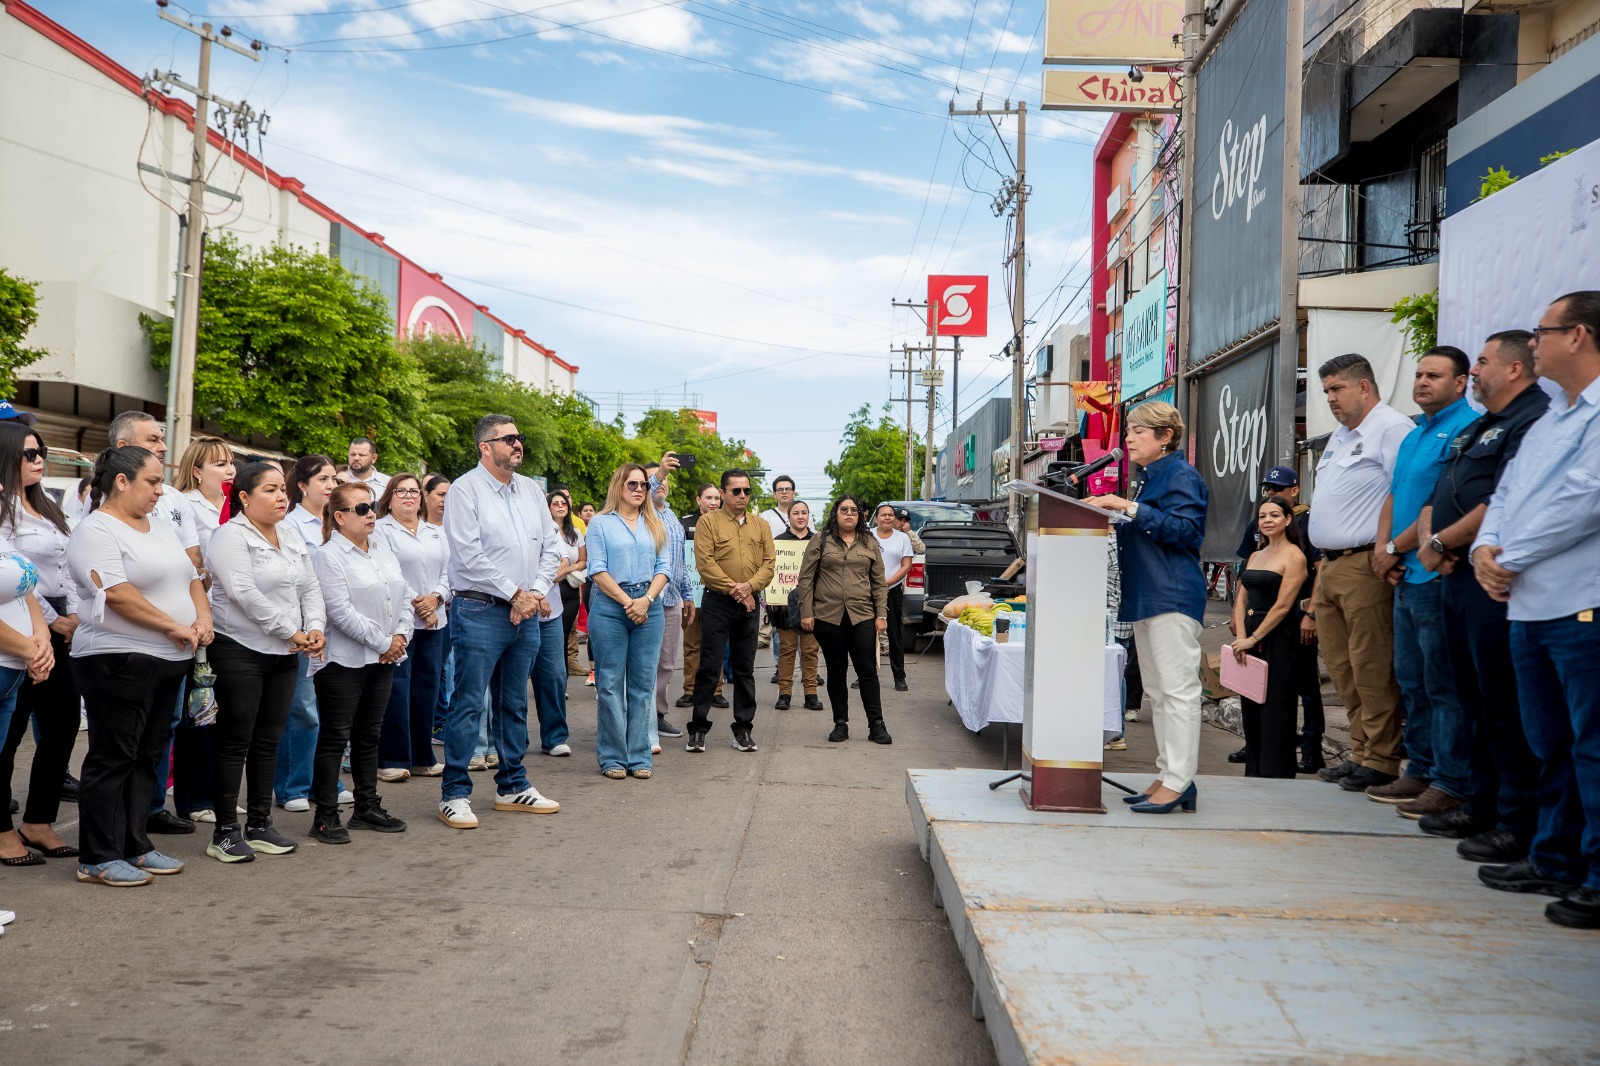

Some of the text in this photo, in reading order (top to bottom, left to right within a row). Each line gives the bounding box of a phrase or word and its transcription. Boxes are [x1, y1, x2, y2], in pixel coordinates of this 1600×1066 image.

[1212, 113, 1267, 223] Step
[1212, 384, 1268, 503] Step
[778, 572, 799, 584] RESP
